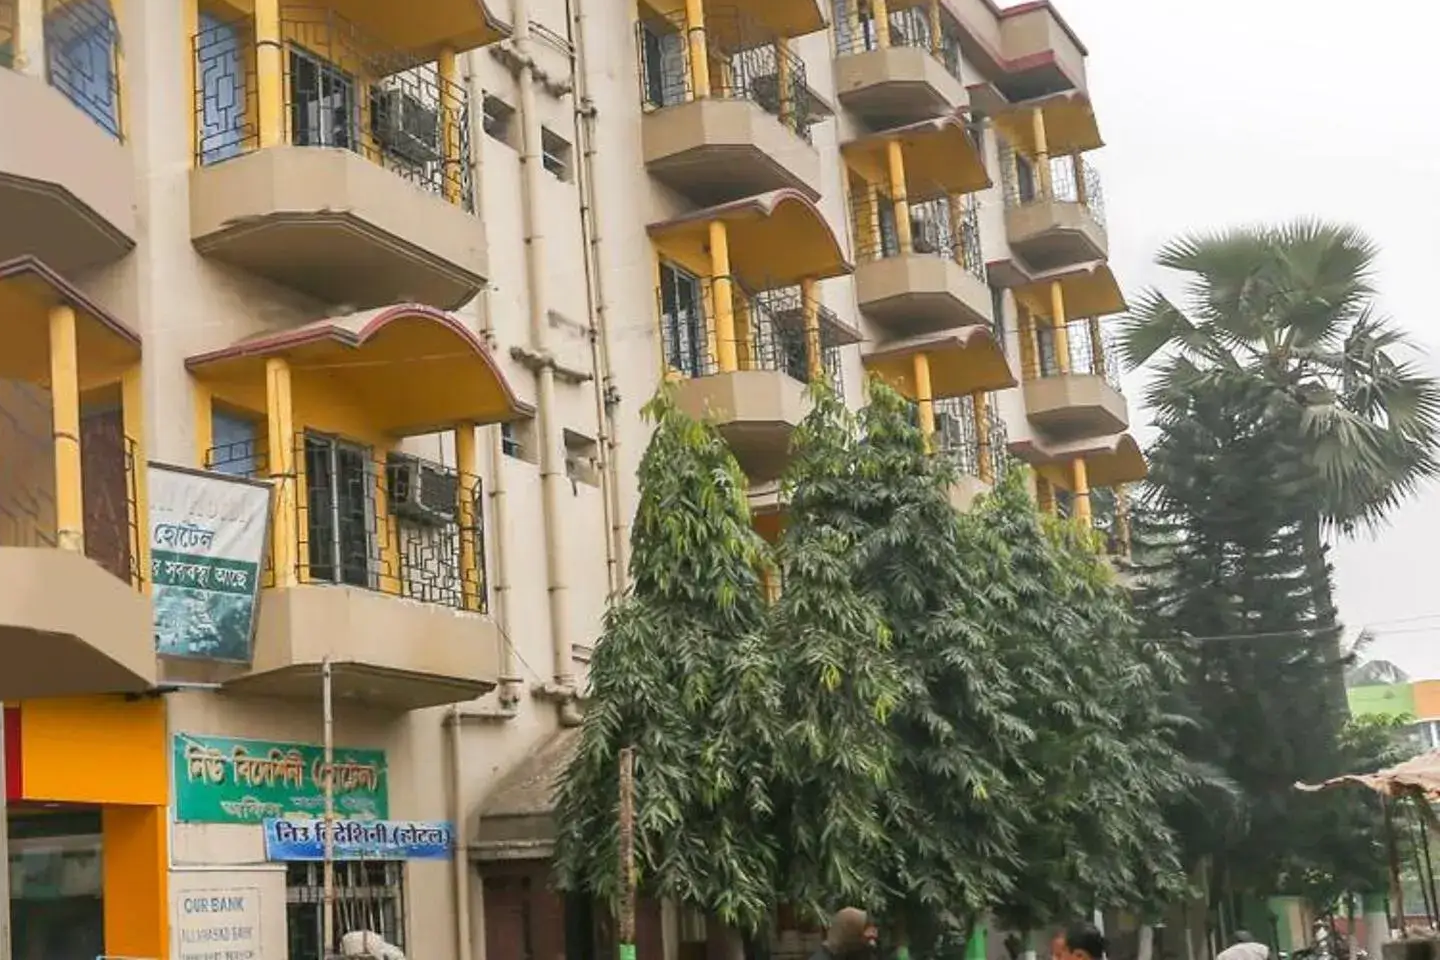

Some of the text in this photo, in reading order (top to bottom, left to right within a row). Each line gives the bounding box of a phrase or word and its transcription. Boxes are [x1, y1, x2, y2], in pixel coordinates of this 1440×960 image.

[154, 522, 215, 550] হোটেল
[214, 566, 249, 590] আছে
[186, 745, 379, 792] নিউ বিদেশিনী (োটেল)
[184, 896, 244, 913] OUR BANK
